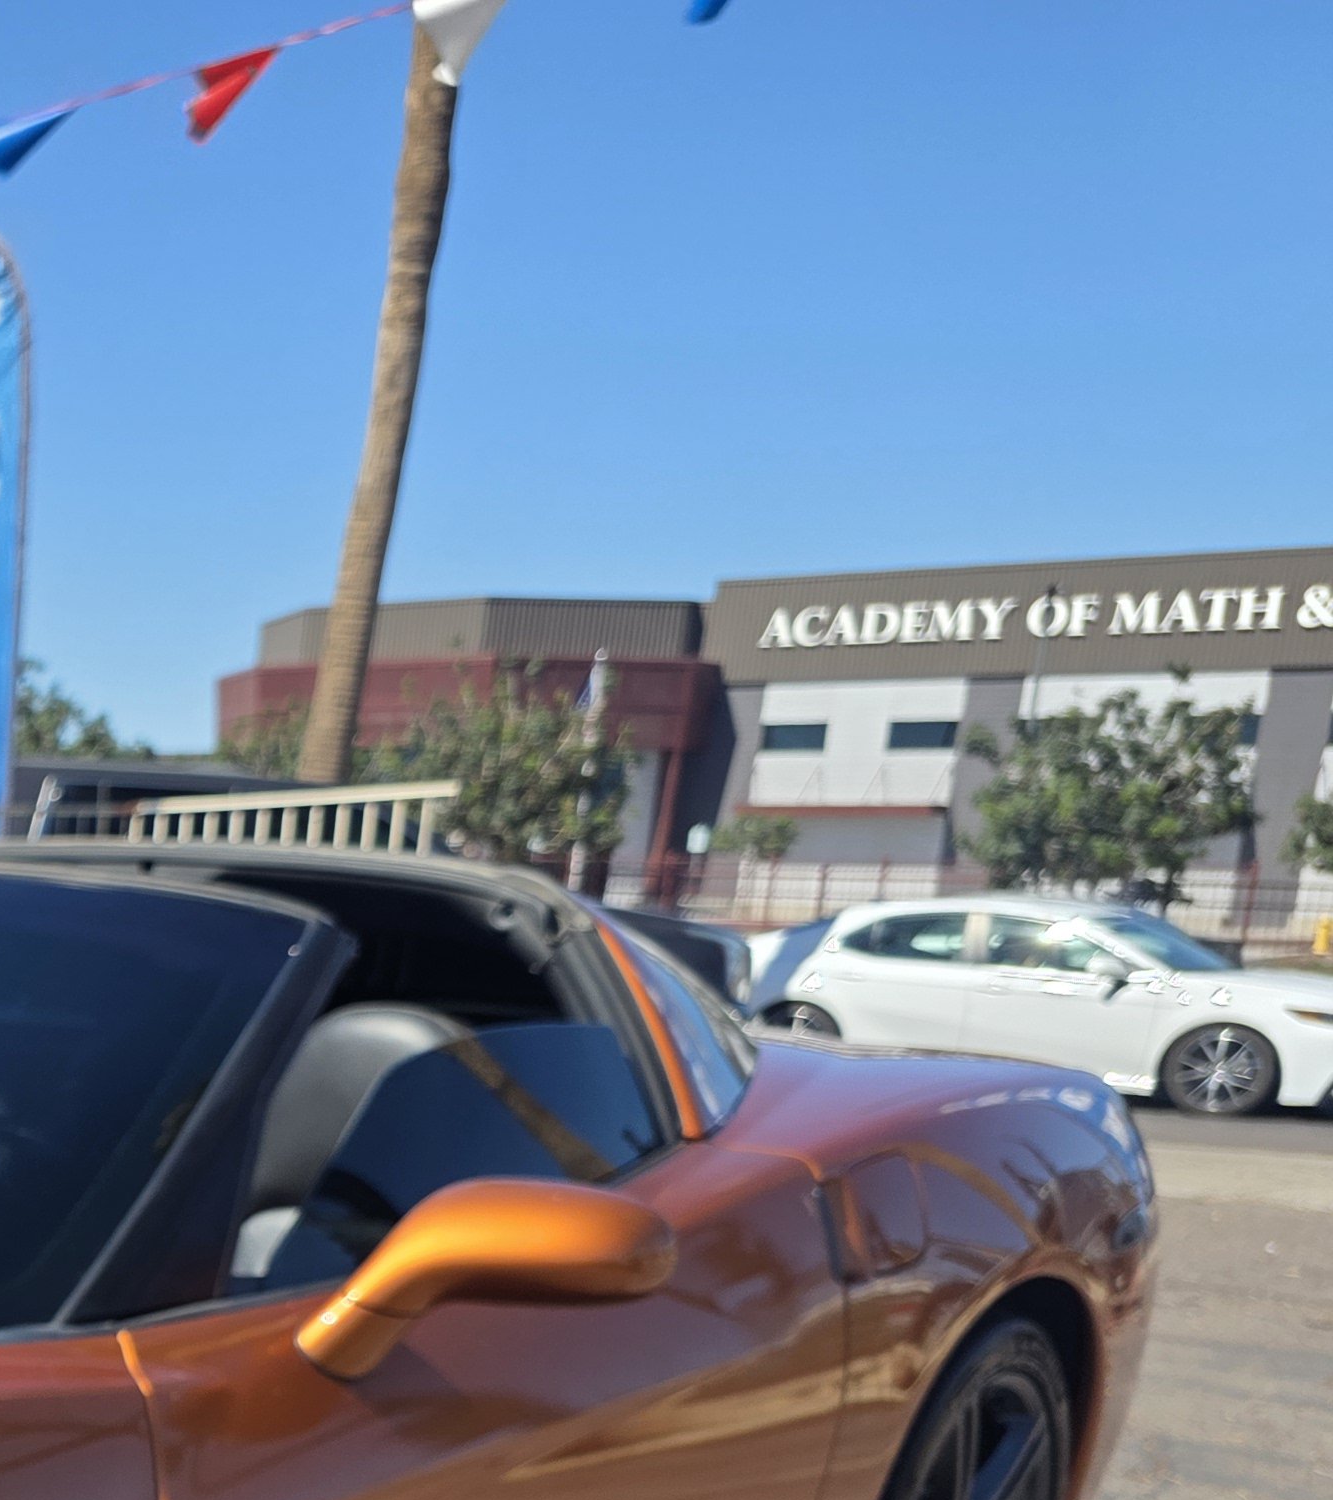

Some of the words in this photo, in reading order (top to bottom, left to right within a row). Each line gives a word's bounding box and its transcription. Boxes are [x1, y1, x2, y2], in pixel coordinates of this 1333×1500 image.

[757, 599, 1017, 648] ACADEMY
[1026, 593, 1100, 639] OF
[1106, 585, 1286, 636] MATH
[1296, 584, 1333, 629] &
